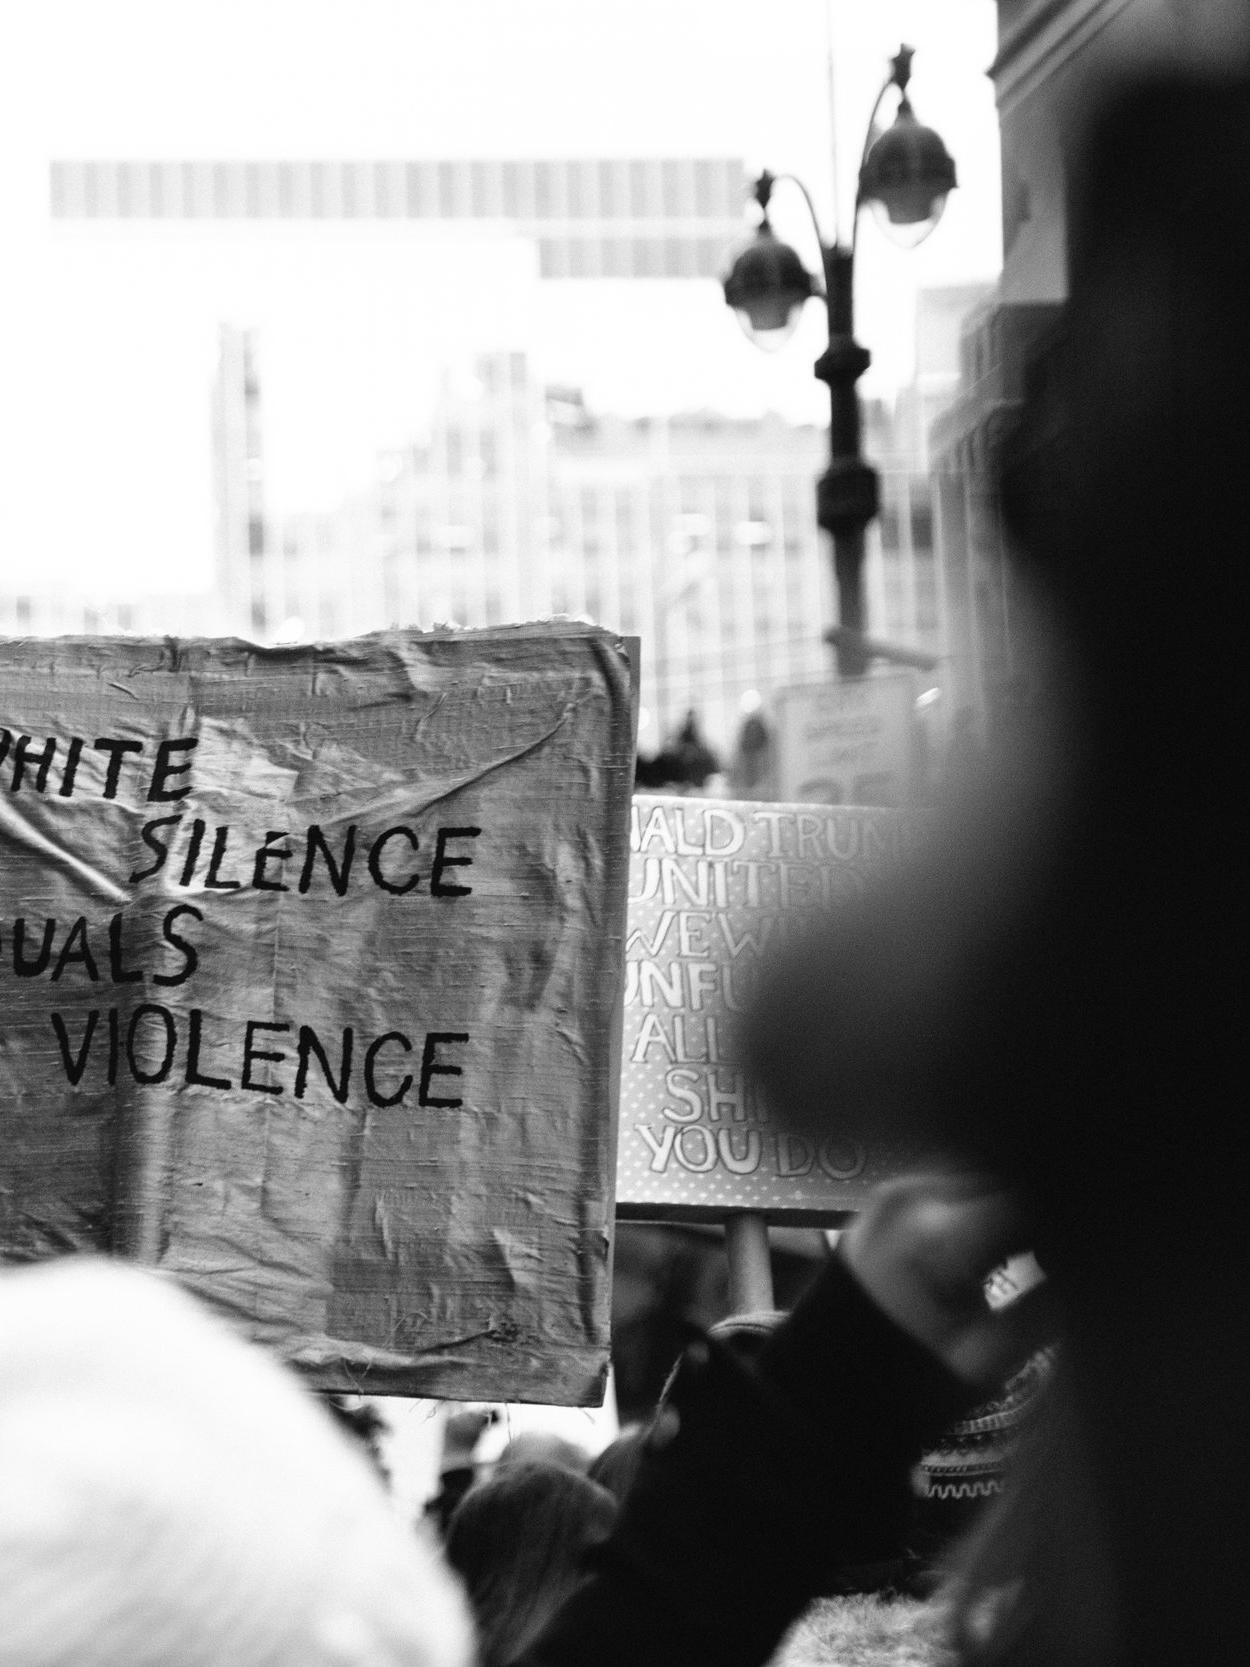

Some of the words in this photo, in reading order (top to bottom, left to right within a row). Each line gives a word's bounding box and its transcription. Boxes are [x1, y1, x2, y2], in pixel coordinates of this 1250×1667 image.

[129, 813, 482, 897] SILENCE
[631, 805, 744, 857] ALD
[625, 961, 758, 1011] NFU
[51, 1003, 469, 1108] VIOLENCE
[634, 1124, 761, 1175] YOU
